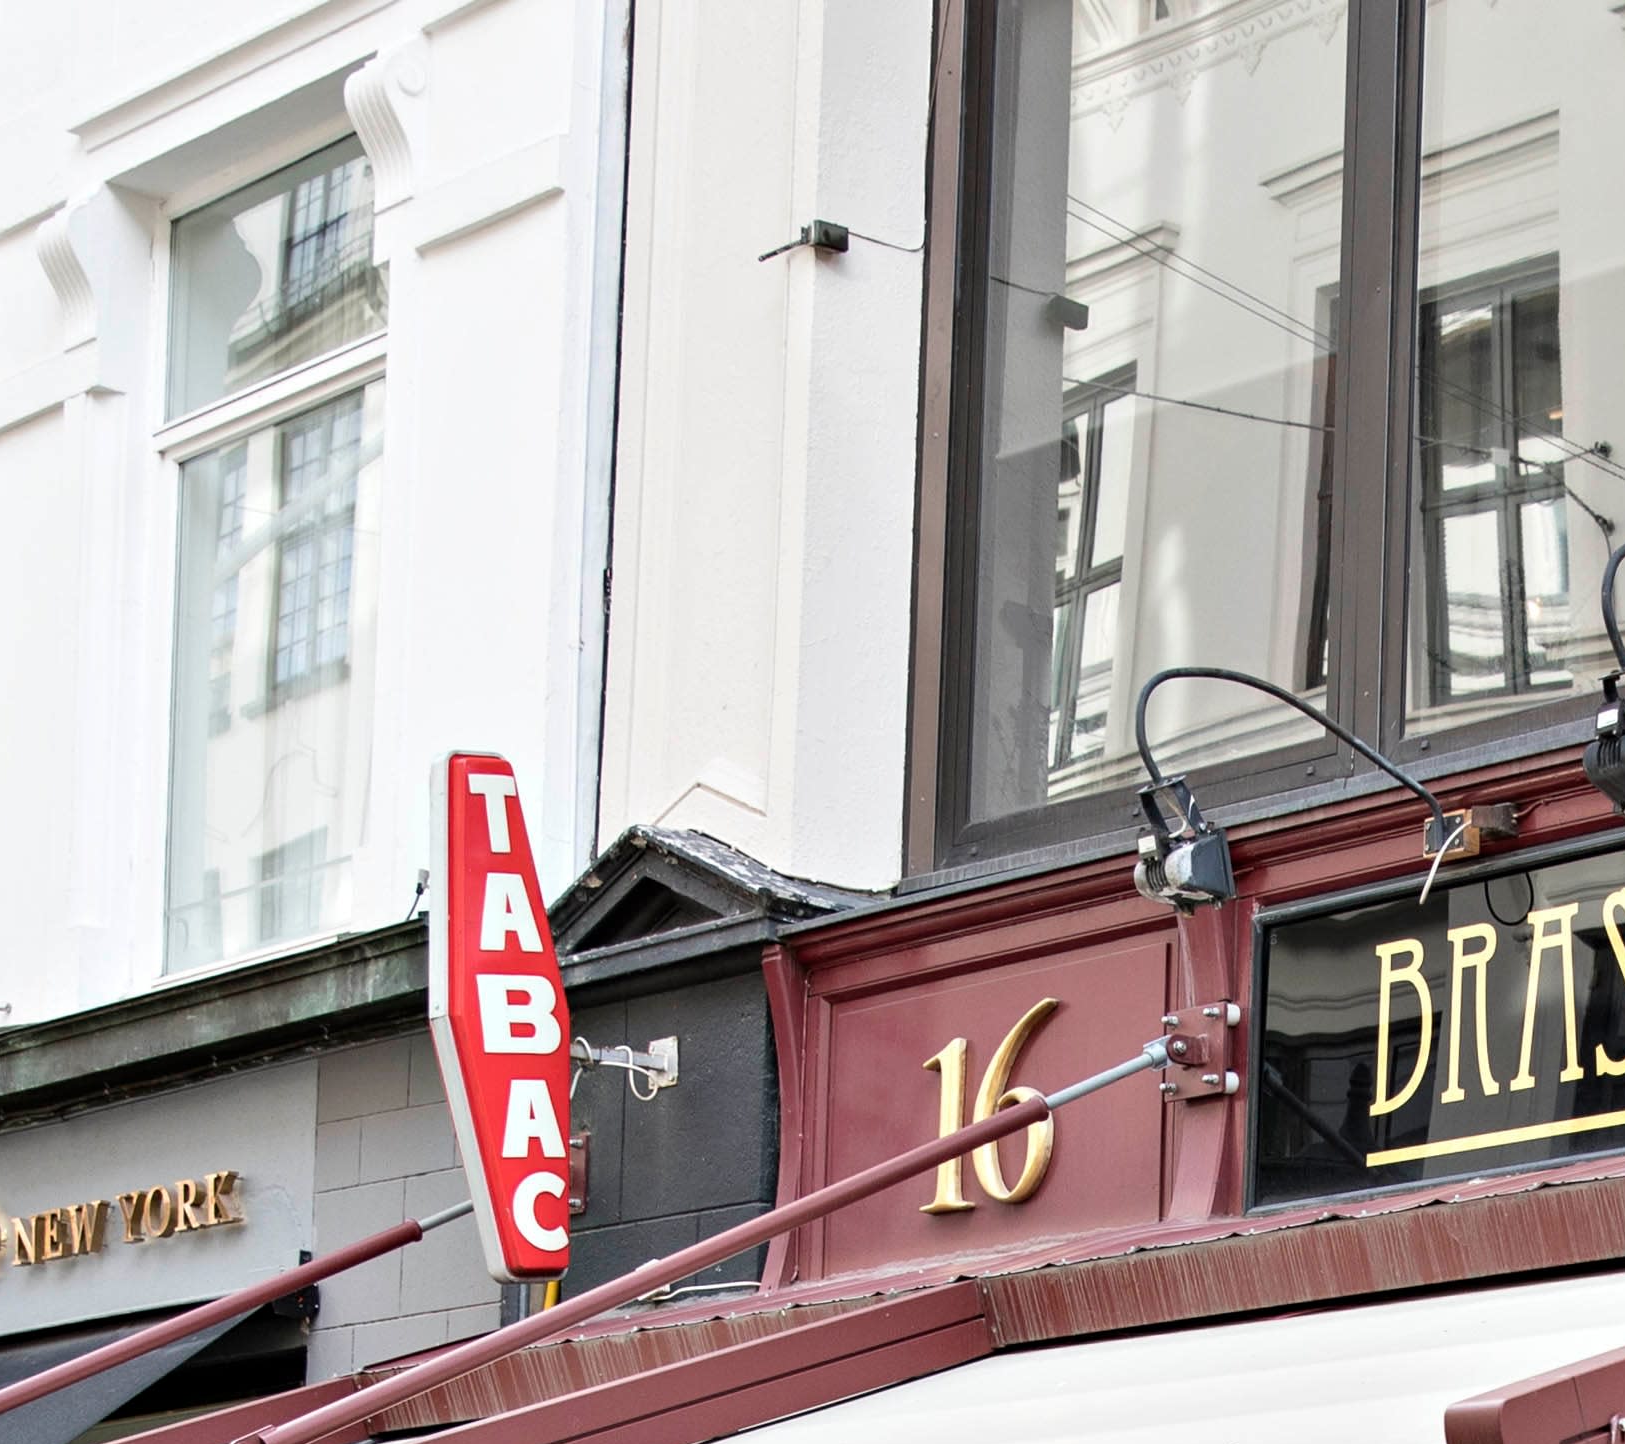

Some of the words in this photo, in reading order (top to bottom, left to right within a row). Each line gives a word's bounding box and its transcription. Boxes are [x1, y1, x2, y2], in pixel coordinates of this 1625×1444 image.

[468, 773, 569, 1252] TABAC
[922, 995, 1062, 1217] 16
[12, 1200, 111, 1265] NEW
[116, 1170, 245, 1243] YORK
